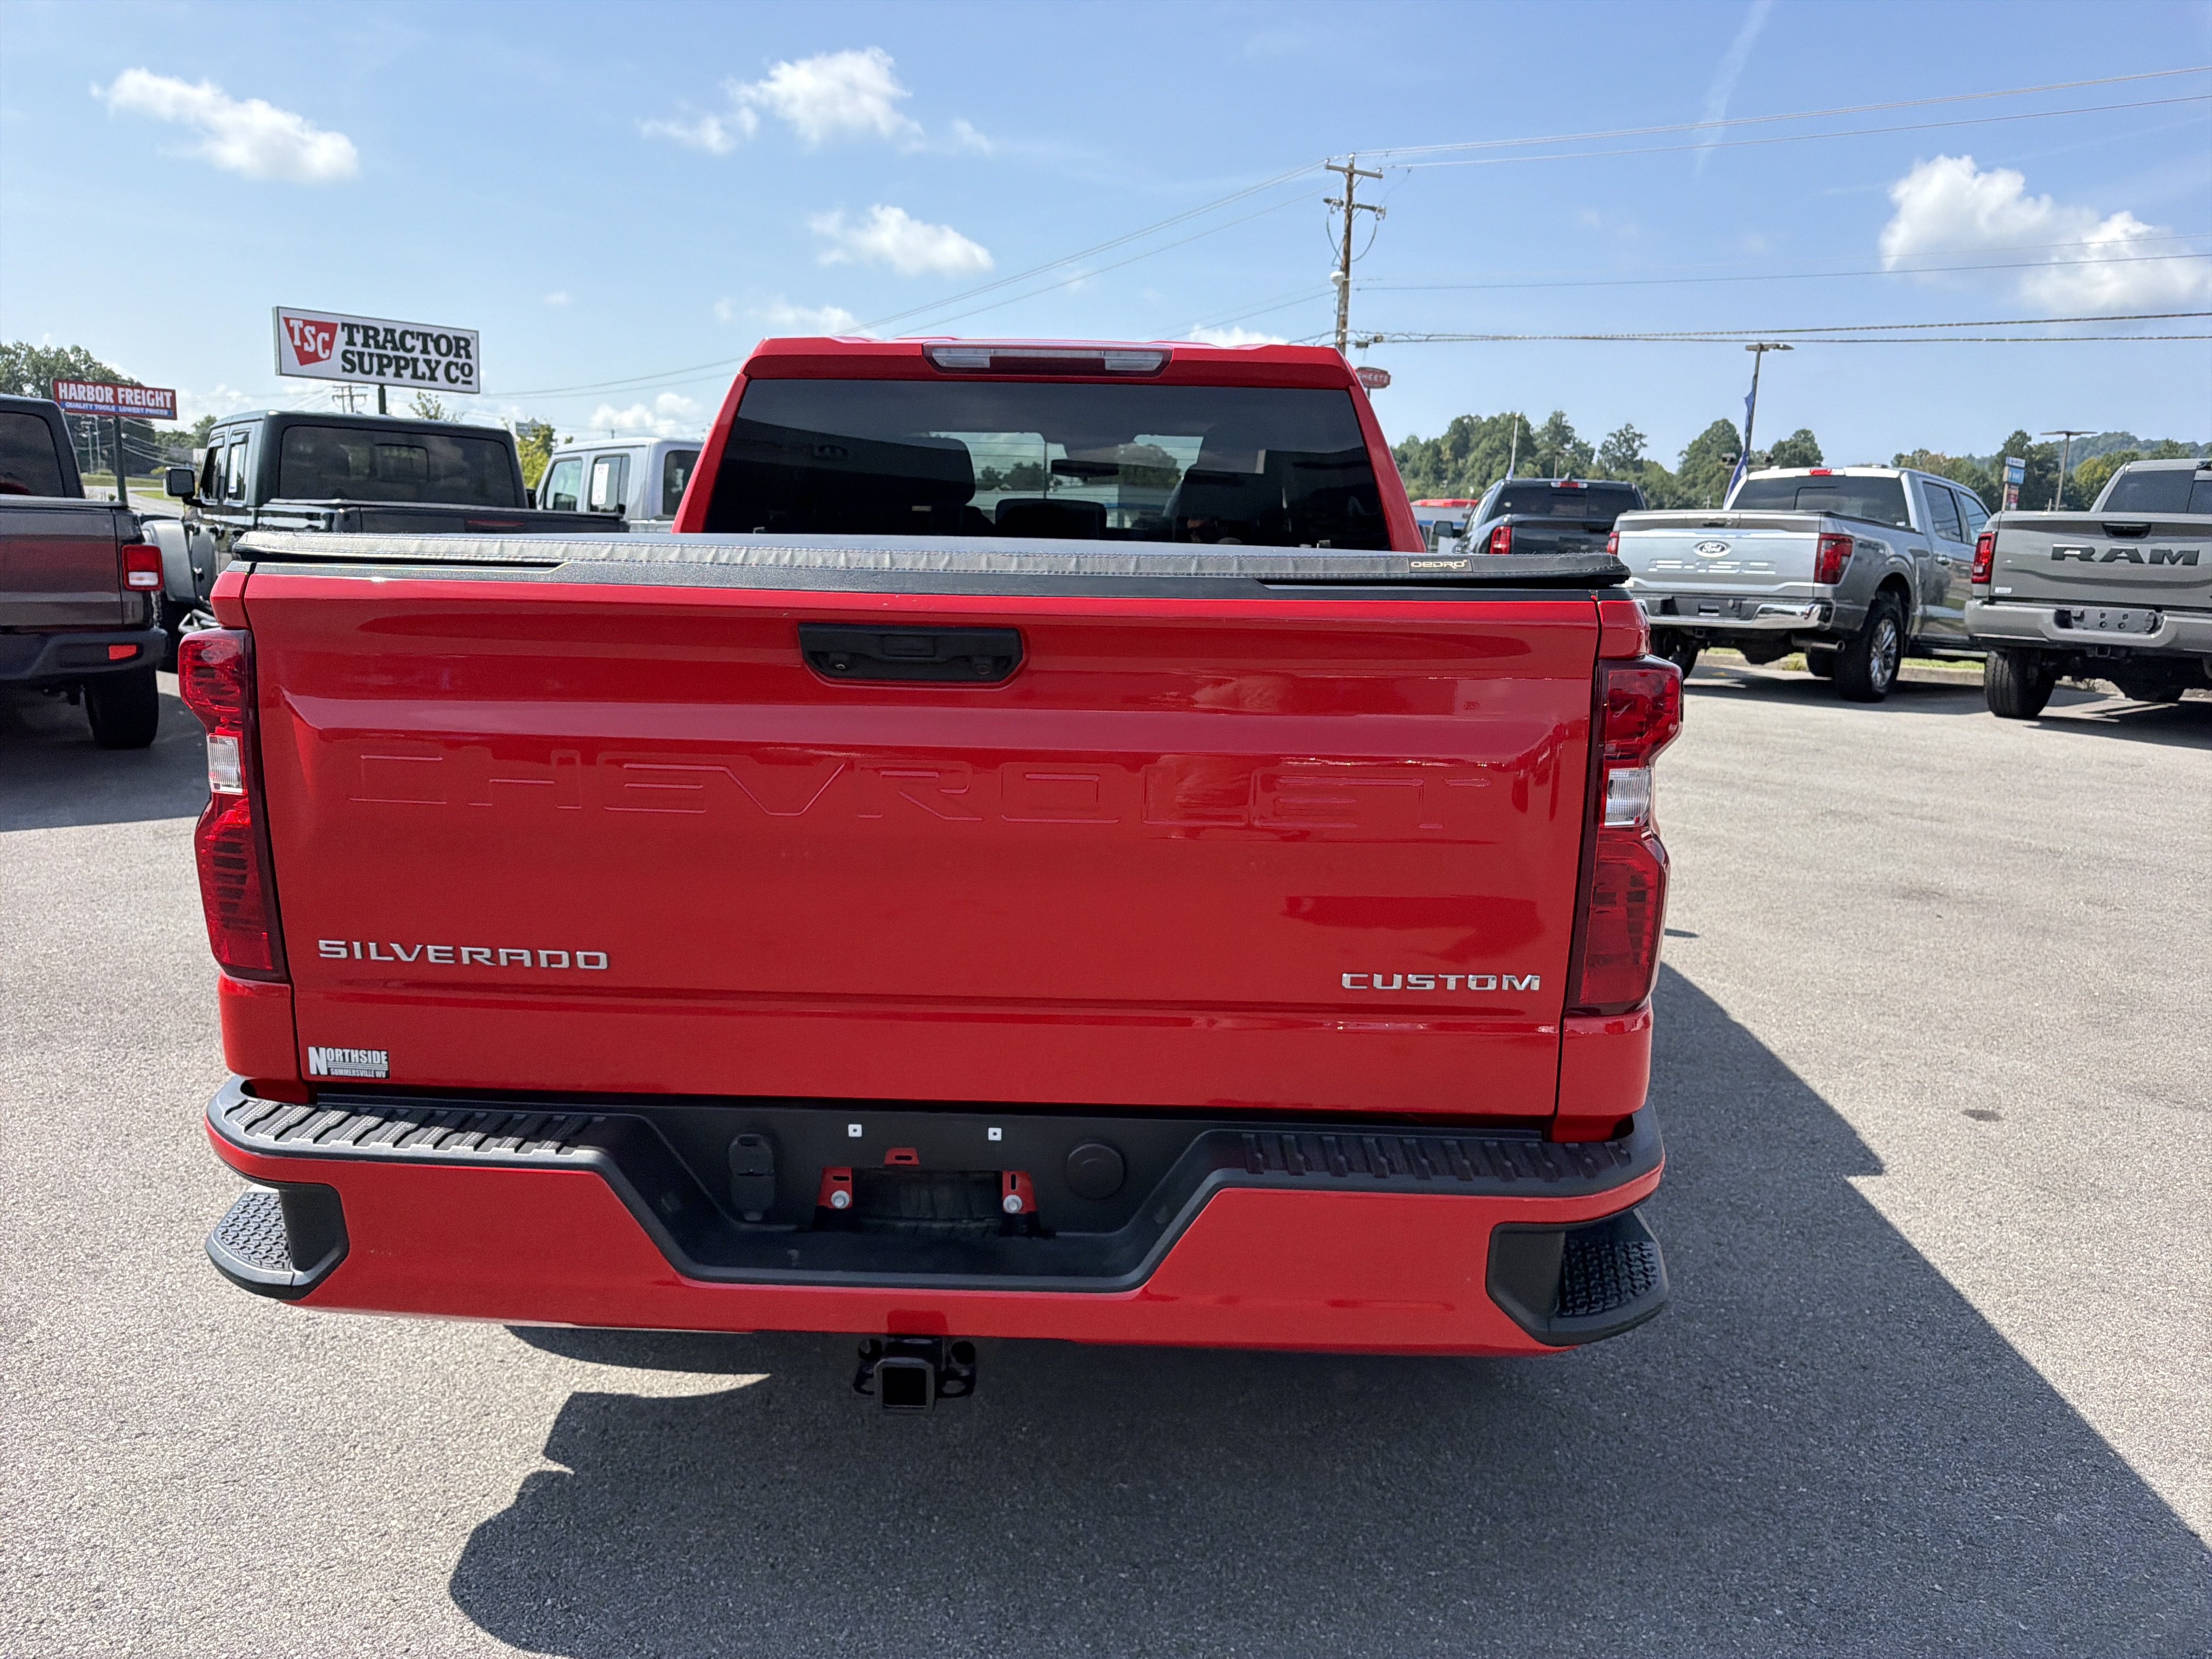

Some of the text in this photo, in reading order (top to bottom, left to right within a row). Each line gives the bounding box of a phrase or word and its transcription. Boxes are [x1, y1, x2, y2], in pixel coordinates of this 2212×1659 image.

[290, 319, 329, 359] TSC
[341, 322, 473, 359] TRACTOR
[341, 349, 441, 382] SUPPLY
[58, 382, 172, 408] HARBOR FREIGHT
[1702, 542, 1722, 552] Ford
[2051, 544, 2200, 566] RAM
[348, 749, 1492, 828] CHEVROLET
[318, 940, 609, 970] SILVERADO
[1341, 973, 1541, 991] CUSTOM
[308, 1046, 388, 1075] NORTHSIDE
[330, 1068, 375, 1078] SUMMERSVILLE
